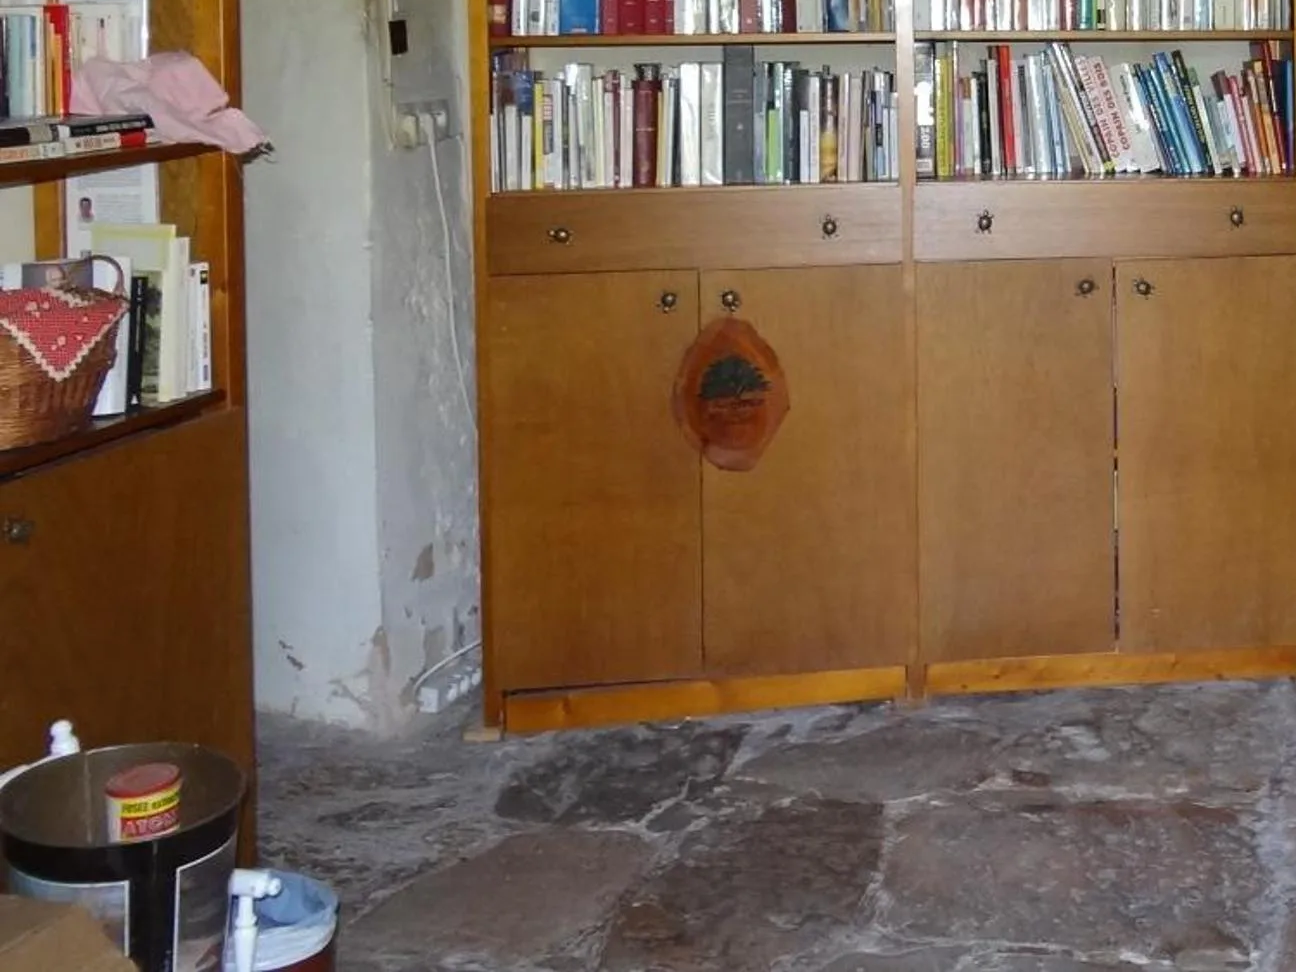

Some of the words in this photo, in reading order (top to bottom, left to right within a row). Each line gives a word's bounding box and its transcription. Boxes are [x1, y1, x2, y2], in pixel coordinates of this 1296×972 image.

[1093, 62, 1108, 87] BOIS
[1092, 95, 1104, 115] DES
[1104, 89, 1116, 108] DES
[1100, 119, 1120, 158] COPAIN
[1110, 111, 1130, 150] COPAIN
